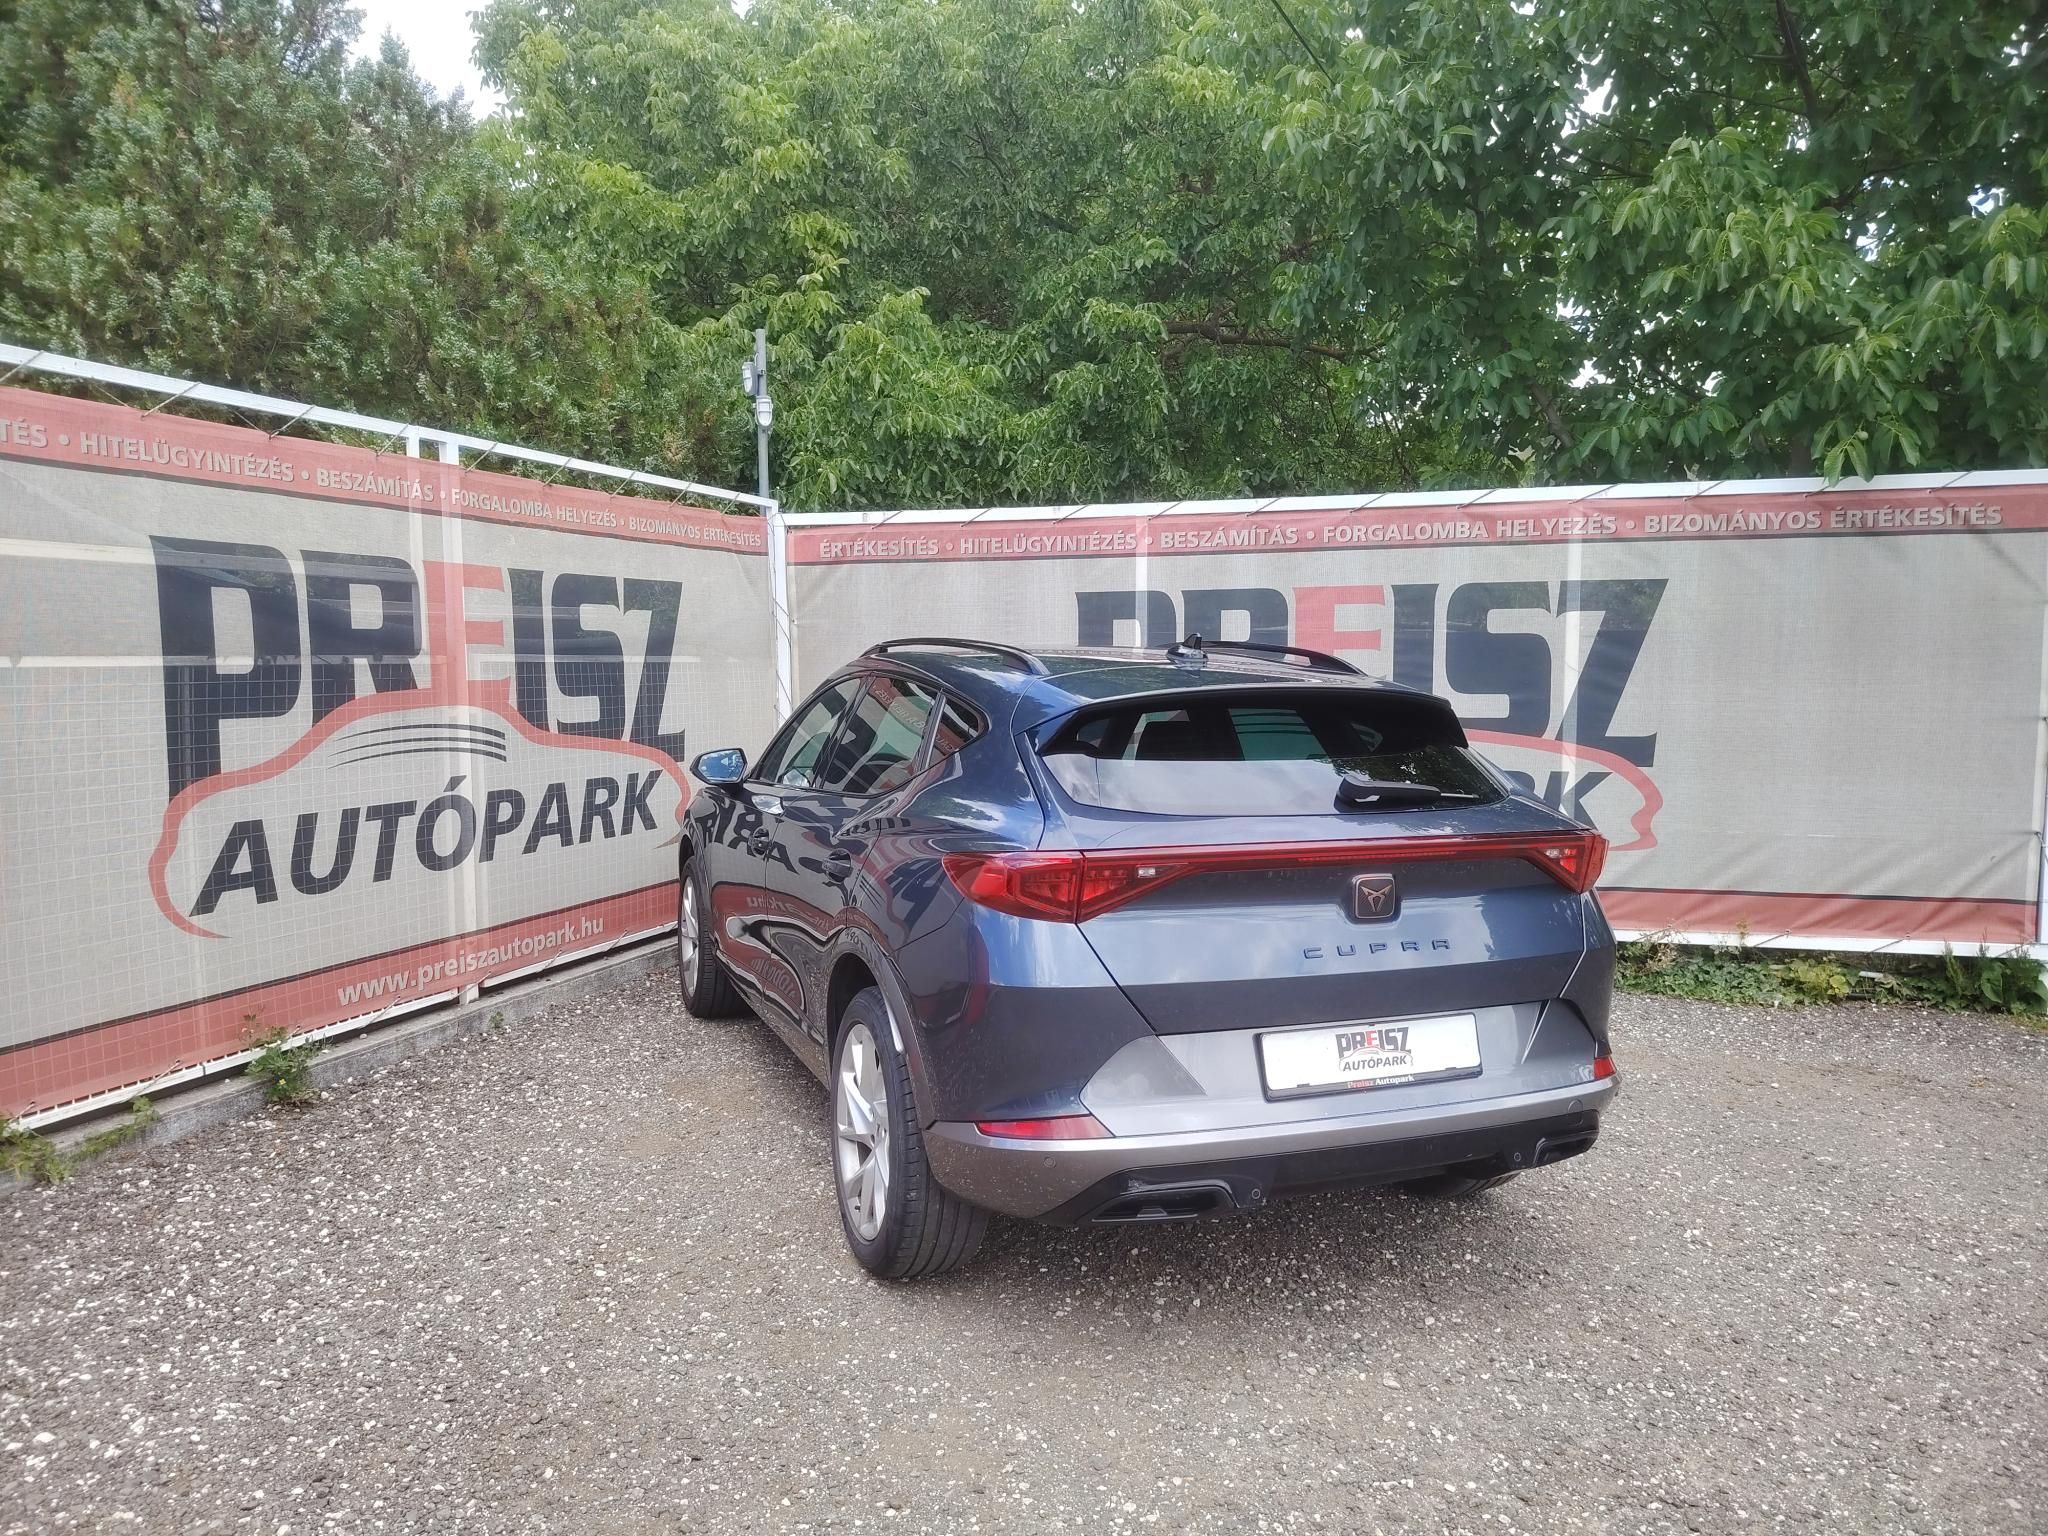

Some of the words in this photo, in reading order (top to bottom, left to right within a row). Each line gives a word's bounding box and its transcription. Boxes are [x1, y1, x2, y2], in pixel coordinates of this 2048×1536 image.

[80, 431, 294, 482] HITELÜGYINTÉZÉS
[316, 467, 434, 501] BESZÁMÍTÁS
[451, 488, 553, 519] FORGALOMBA
[556, 507, 617, 528] HELYEZÉS
[629, 516, 701, 540] BIZOMÁNYOS
[819, 535, 940, 559] ÉRTÉKESÍTÉS
[960, 529, 1138, 555] HITELÜGYINTÉZÉS
[1160, 523, 1299, 549] BESZÁMÍTÁS
[1323, 519, 1489, 544] FORGALOMBA
[1496, 513, 1618, 538] HELYEZÉS
[1644, 508, 1822, 534] BIZOMÁNYOS
[1830, 503, 2002, 529] ÉRTÉKESÍTÉS
[149, 535, 686, 803] PREISZ
[189, 769, 664, 917] AUTÓPARK
[337, 917, 605, 1006] www.preiszautopark.hu
[1302, 937, 1451, 960] CUPRA
[1335, 1026, 1412, 1059] PREISZ
[1343, 1055, 1408, 1072] AUTÓPARK
[1375, 1074, 1415, 1087] Autopark
